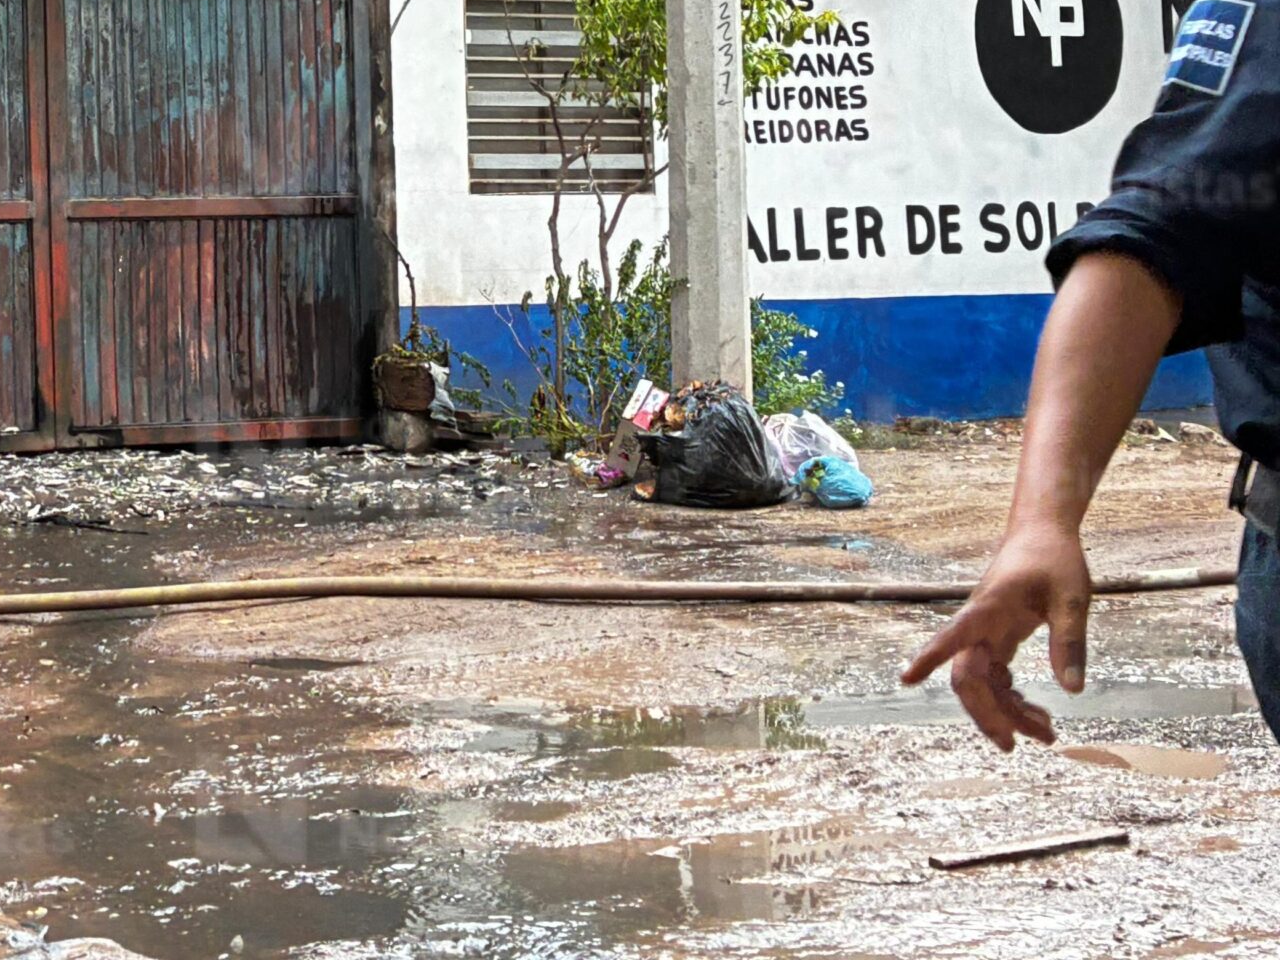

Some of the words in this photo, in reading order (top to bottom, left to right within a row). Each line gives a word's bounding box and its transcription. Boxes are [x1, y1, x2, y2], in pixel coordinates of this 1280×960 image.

[743, 85, 867, 110] TUFONES
[906, 204, 963, 255] DE
[979, 200, 1096, 254] SOL
